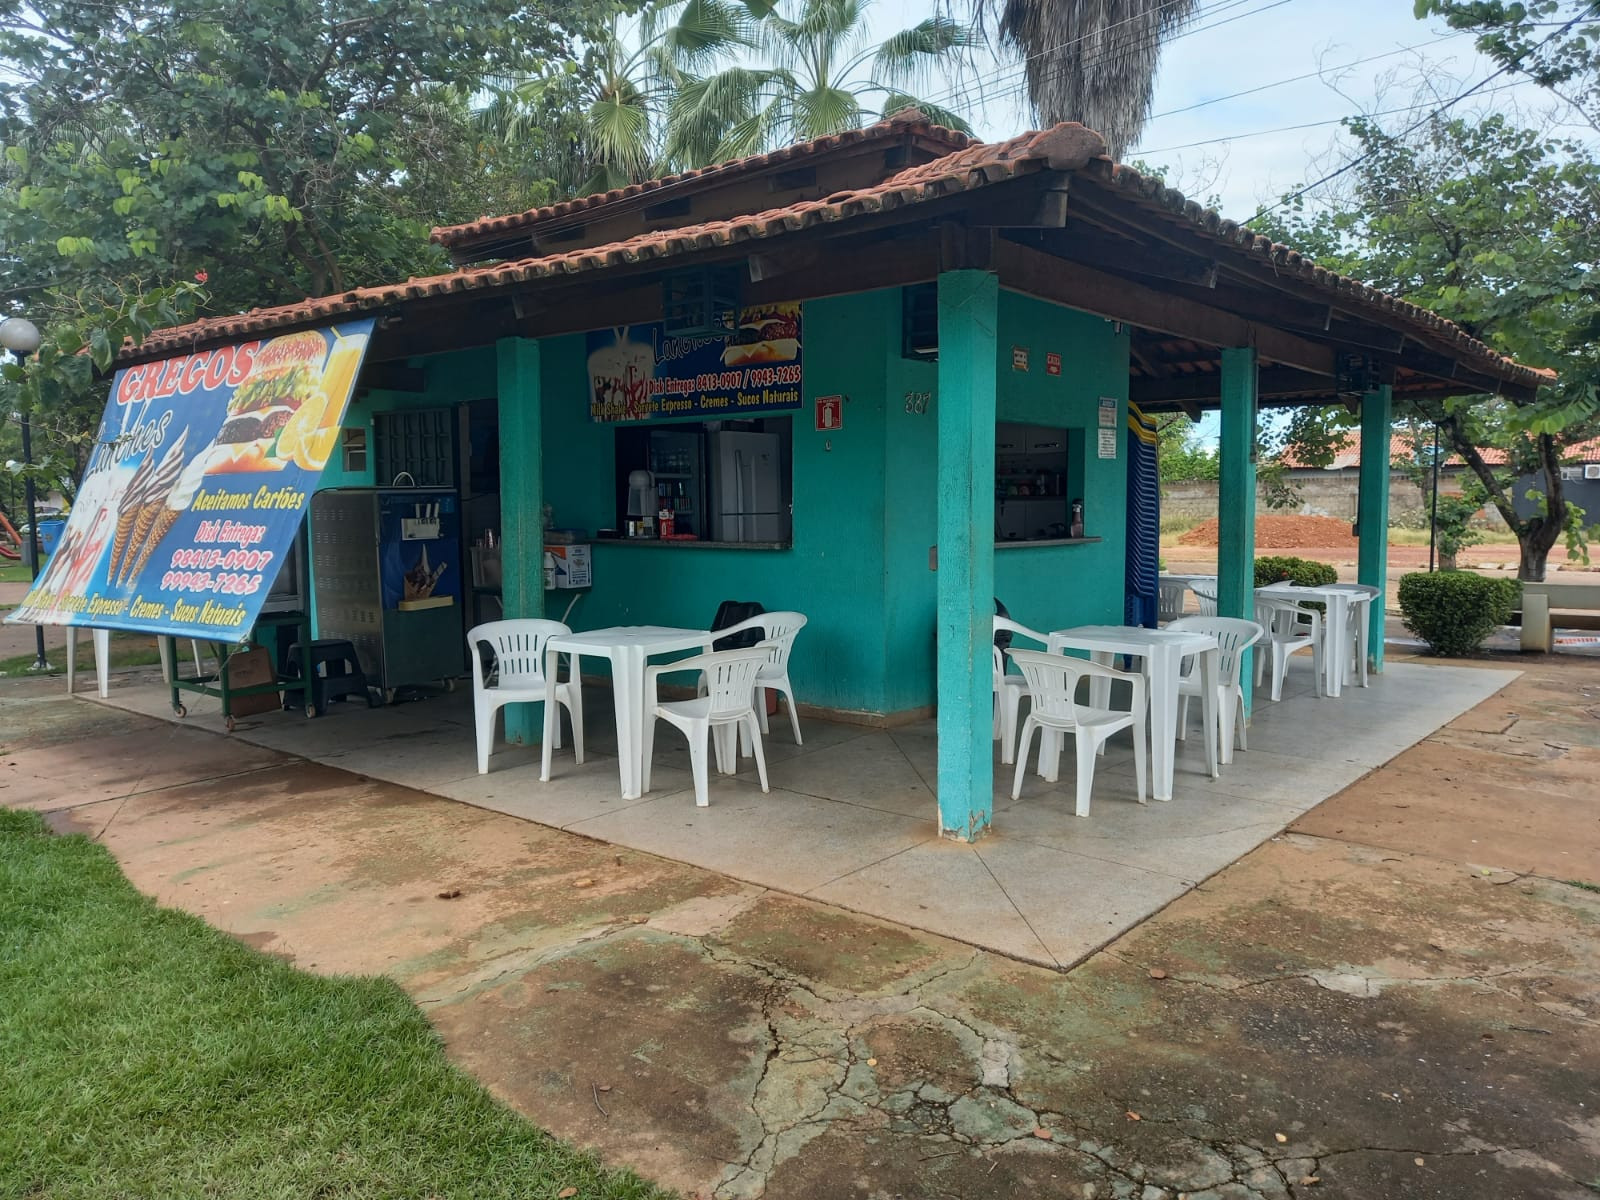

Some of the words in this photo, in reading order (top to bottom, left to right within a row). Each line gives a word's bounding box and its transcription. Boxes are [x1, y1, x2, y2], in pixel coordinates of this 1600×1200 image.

[116, 340, 260, 406] GREGOS
[648, 377, 665, 395] Disk
[665, 375, 696, 398] Entrega:
[696, 370, 742, 392] 8413-0907
[750, 364, 802, 388] 9943-7265
[661, 397, 693, 415] Expresso
[699, 394, 729, 409] Cremes
[736, 391, 761, 407] Sucos
[762, 388, 799, 405] Naturais
[191, 488, 252, 512] Aceitamos
[252, 485, 305, 510] Cartões
[194, 519, 221, 543] Disk
[217, 520, 266, 549] Entrega:
[170, 548, 274, 571] 98413-0907
[160, 570, 263, 595] 99943-7265
[87, 591, 123, 621] Expresso
[129, 594, 165, 620] Cremes
[170, 597, 200, 623] Sucos
[197, 599, 247, 627] Naturais
